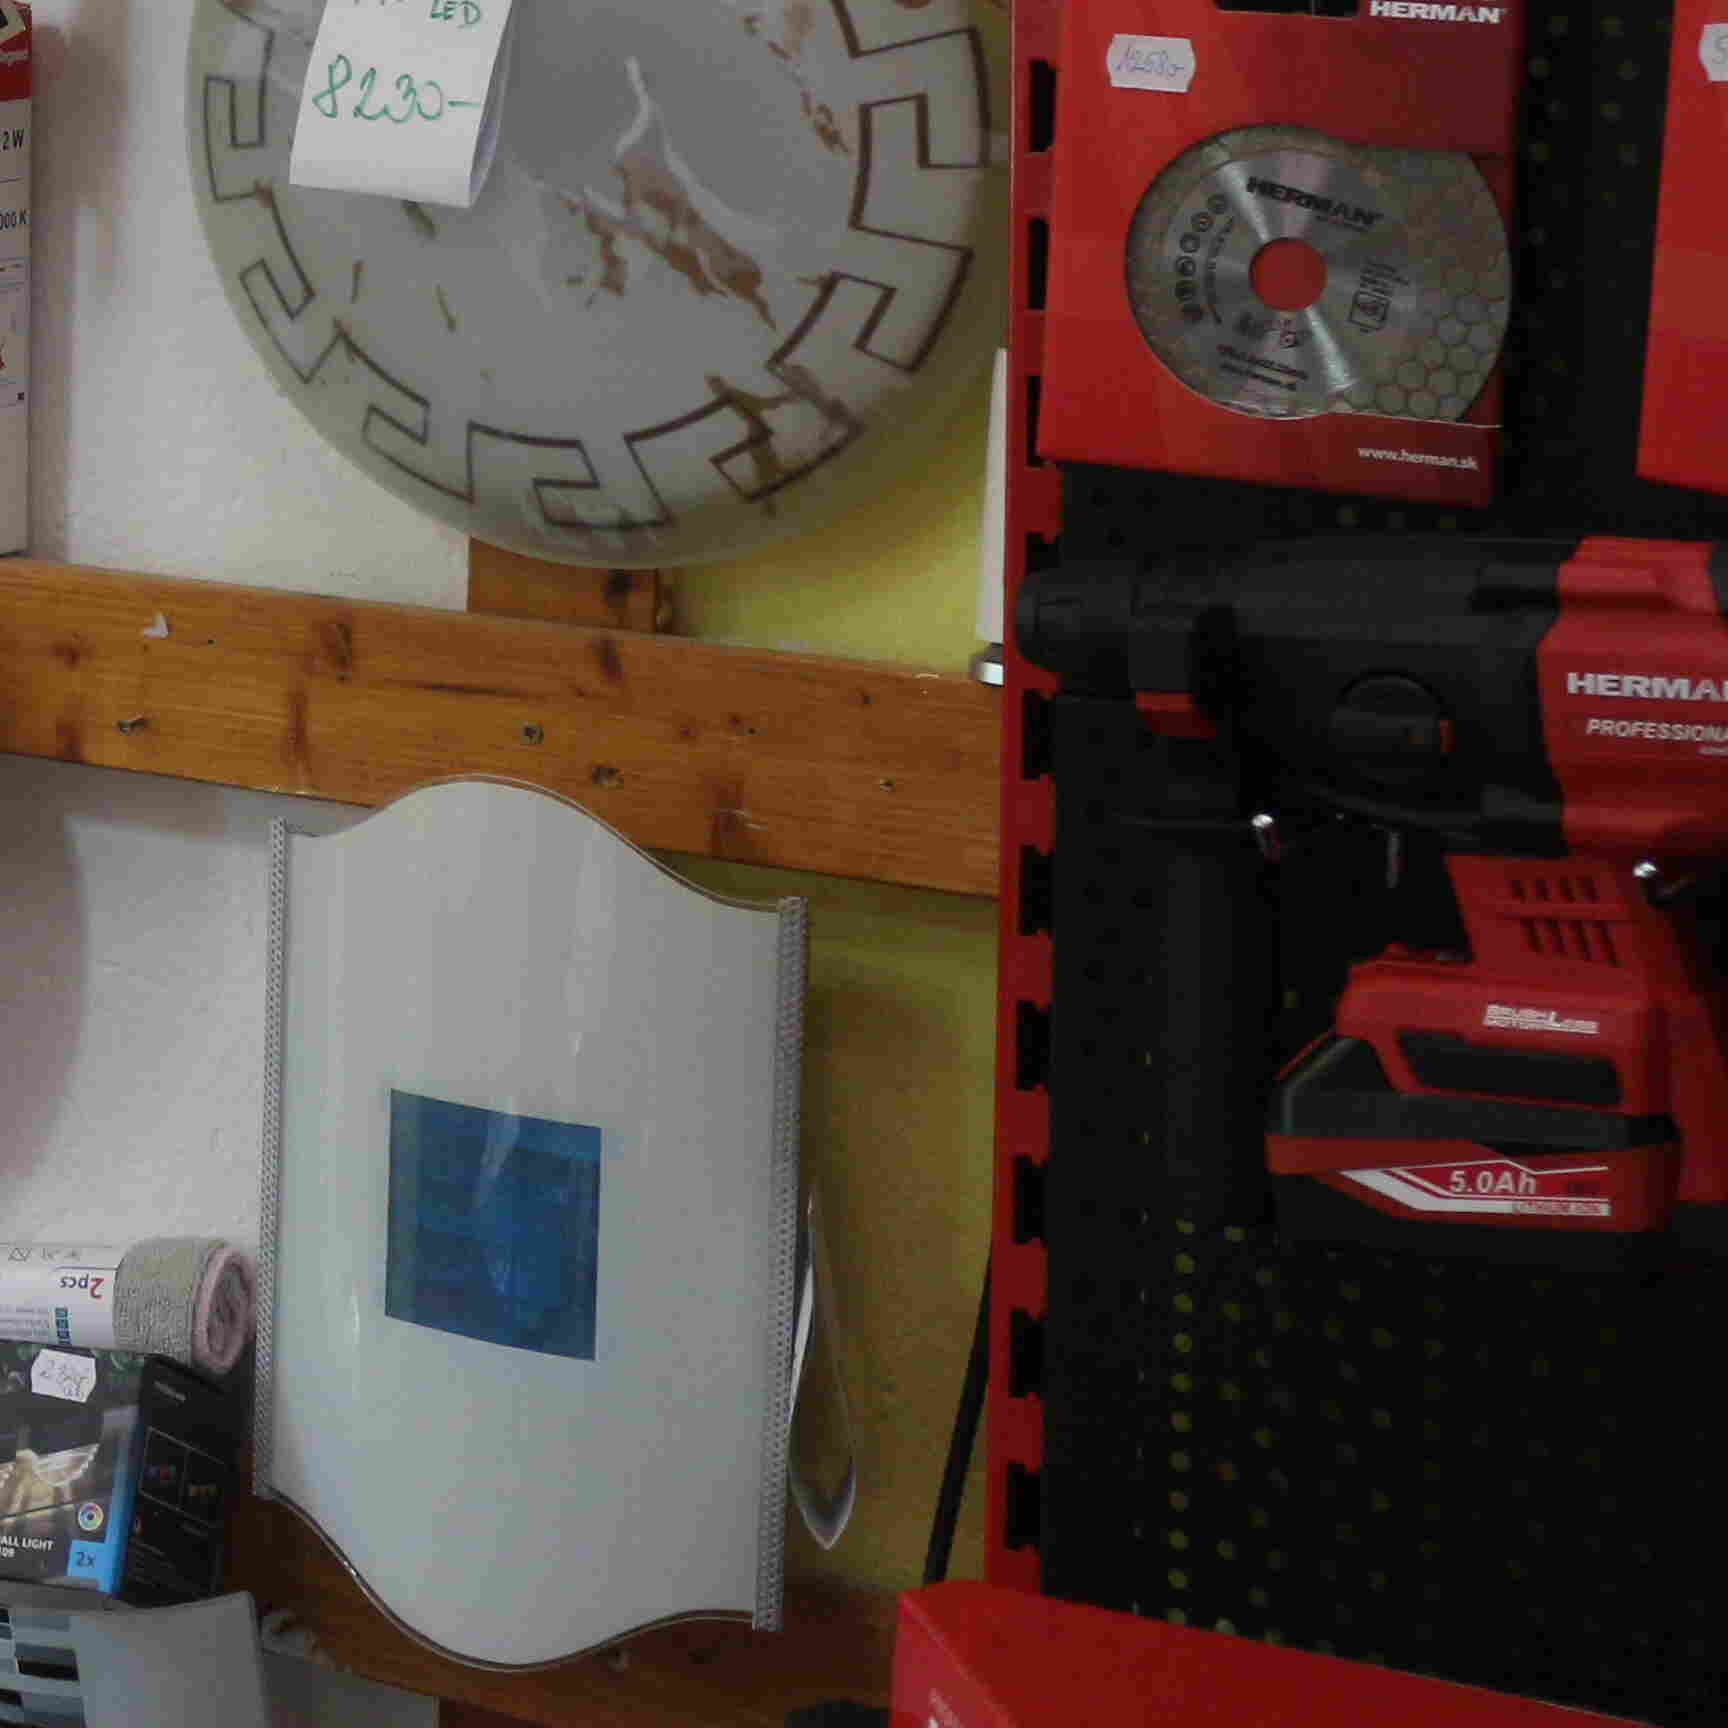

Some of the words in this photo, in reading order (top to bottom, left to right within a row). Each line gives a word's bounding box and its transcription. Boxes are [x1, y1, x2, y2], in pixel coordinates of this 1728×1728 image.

[1369, 0, 1501, 24] HERMAN
[12, 129, 24, 148] W
[1247, 176, 1378, 225] HERMAN
[1567, 672, 1728, 703] HERMA
[1449, 1171, 1537, 1195] 5.0Ah
[22, 1536, 55, 1552] LIGHT
[76, 1551, 96, 1569] 2x
